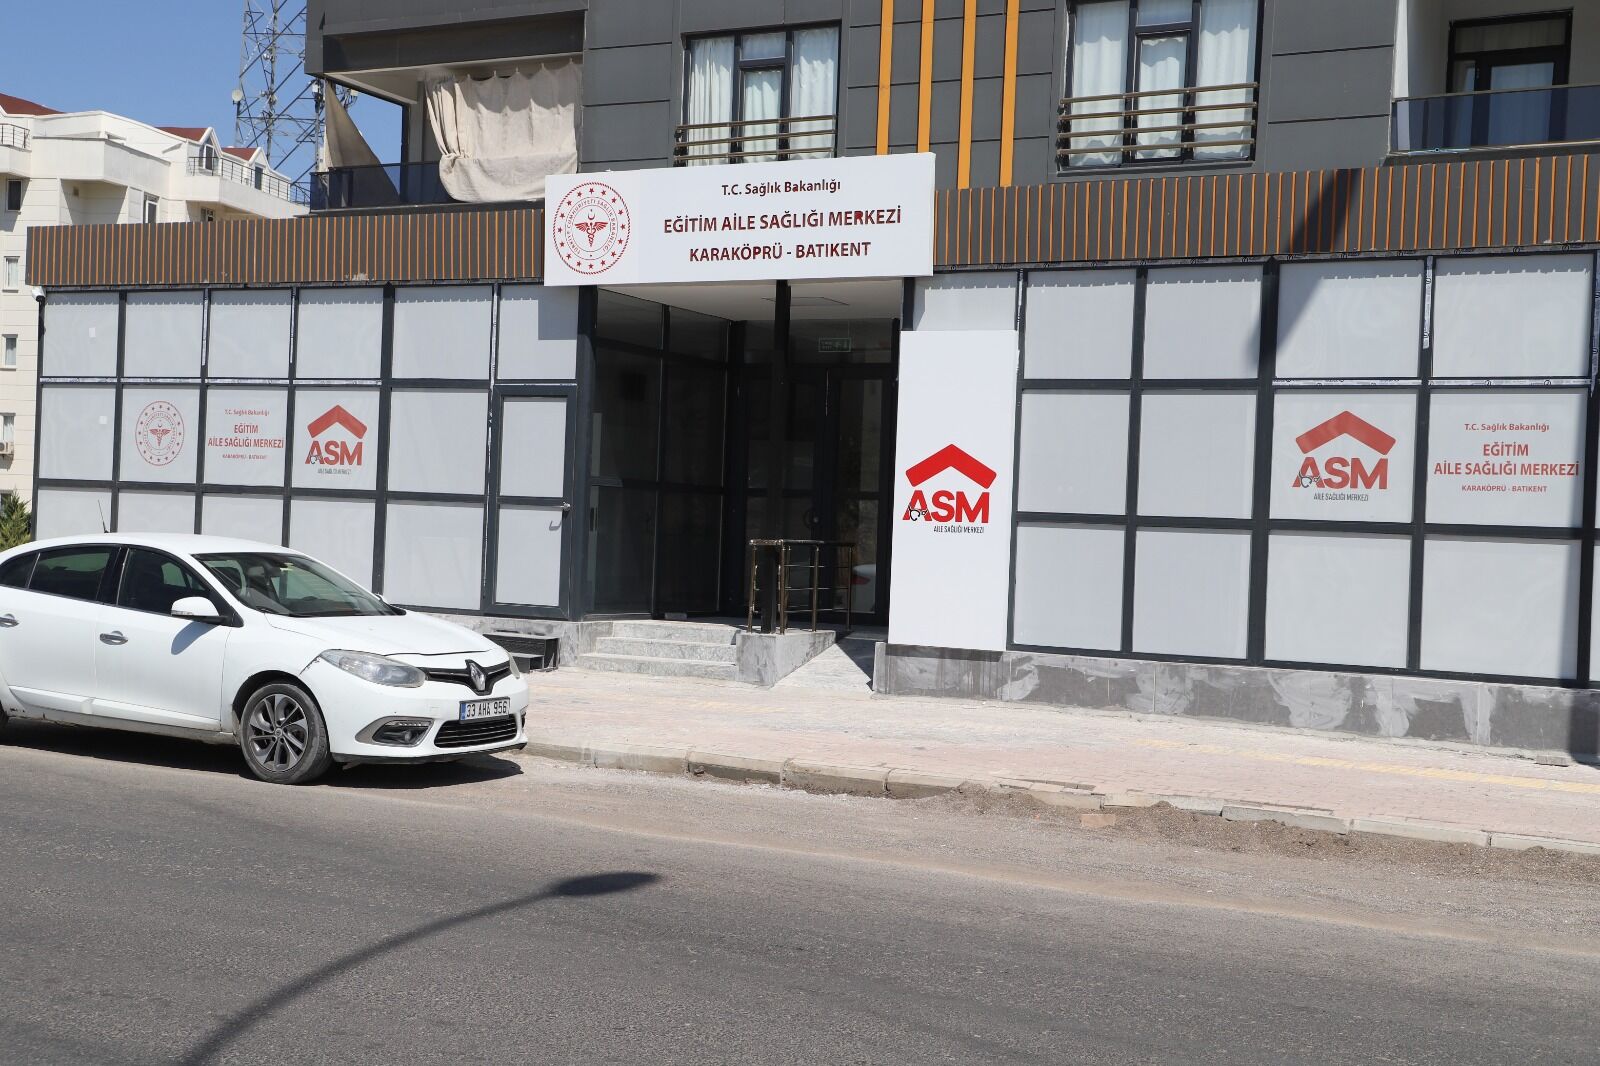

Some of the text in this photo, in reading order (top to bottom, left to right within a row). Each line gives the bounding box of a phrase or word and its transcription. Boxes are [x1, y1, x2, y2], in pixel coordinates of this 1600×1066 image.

[721, 179, 841, 197] T.C. Sağlık Bakanlığı
[664, 205, 902, 233] EĞİTİM AİLE SAĞLIĞI MERKEZİ
[689, 242, 783, 262] KARAKÖPRÜ
[795, 241, 871, 259] BATIKENT
[234, 422, 259, 434] EĞİTİM
[1464, 423, 1550, 432] T.C. Sağlık Bakanlığı
[207, 435, 284, 449] AİLE SAĞLIĞI MERKEZİ
[1483, 441, 1529, 457] EĞİTİM
[304, 440, 363, 466] ASM
[1291, 456, 1389, 490] ASM
[1433, 460, 1579, 476] AİLE SAĞLIĞI MERKEZİ
[1461, 484, 1507, 492] KARAKÖPRÜ
[1511, 485, 1548, 493] BATIKENT
[902, 489, 990, 524] ASM
[466, 703, 476, 718] 33
[493, 700, 508, 715] 956
